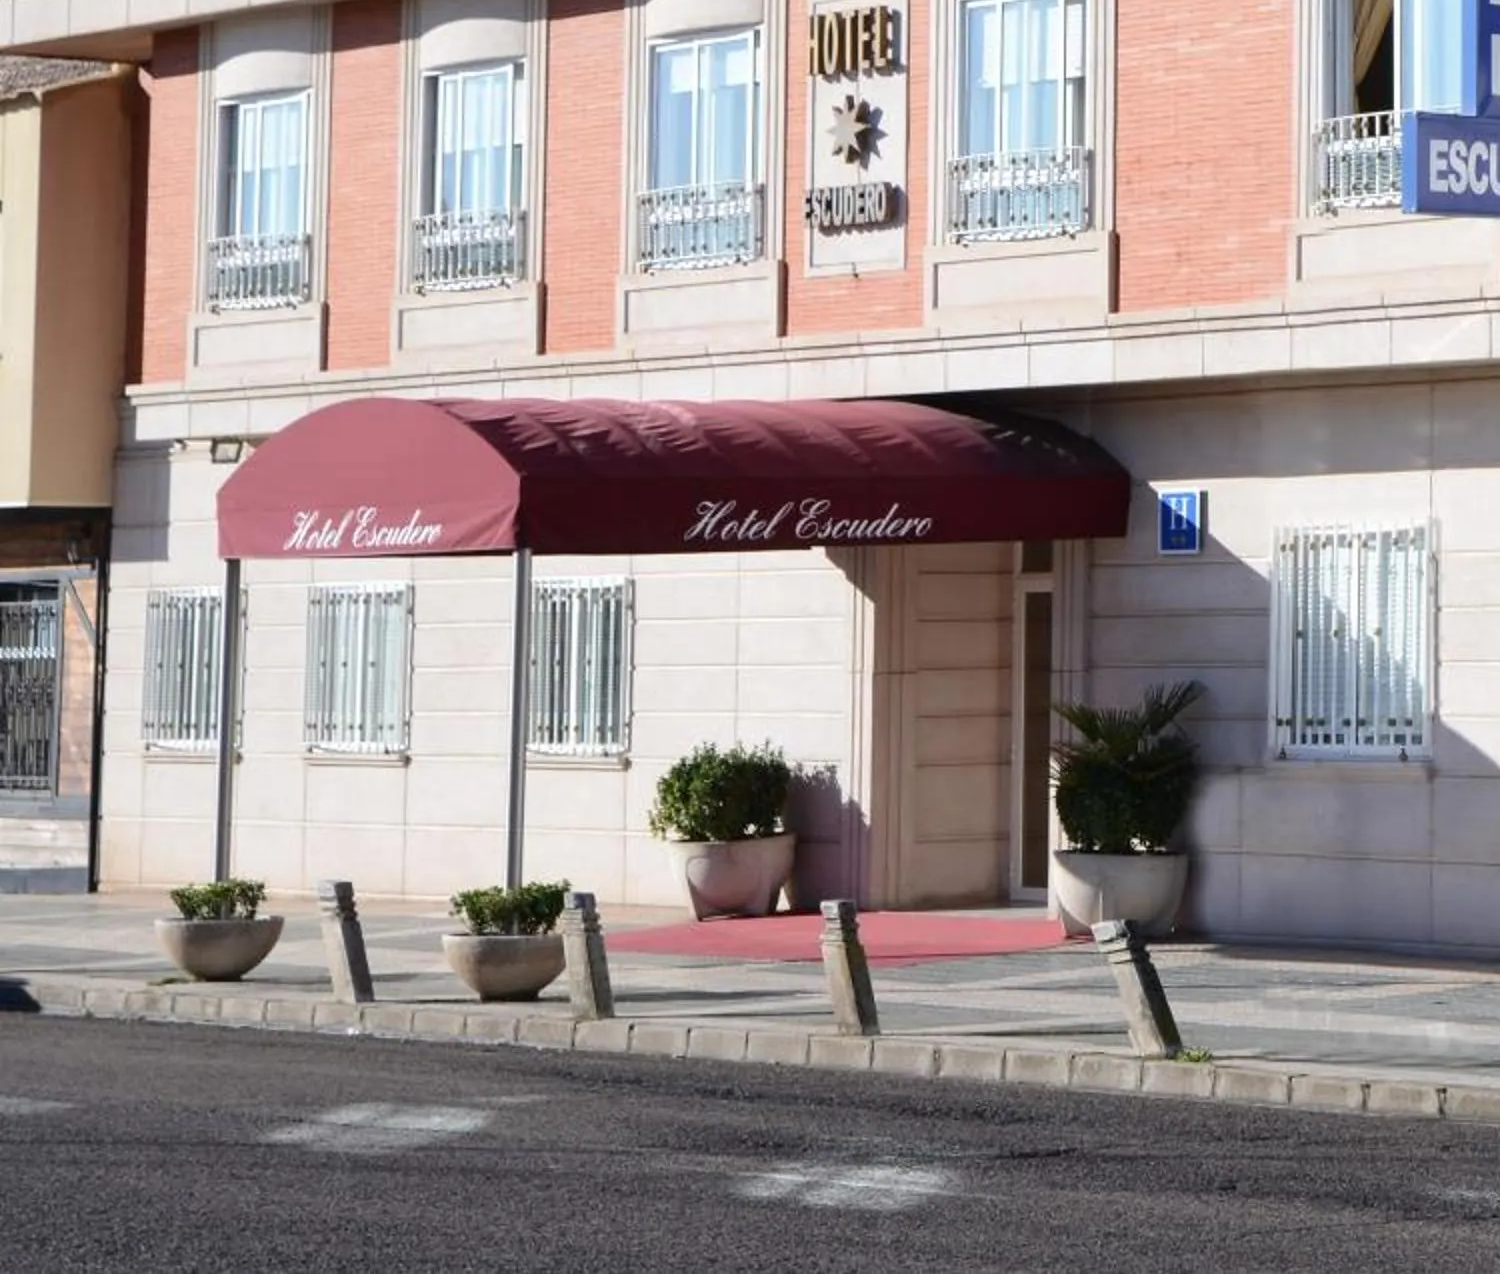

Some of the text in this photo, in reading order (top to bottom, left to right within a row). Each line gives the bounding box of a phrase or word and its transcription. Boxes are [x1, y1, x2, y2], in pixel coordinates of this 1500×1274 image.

[804, 4, 888, 76] HOTEL
[803, 182, 887, 227] ESCUDERO
[283, 505, 443, 551] Hotel Escudero
[683, 497, 934, 541] Hotel Escudero
[1168, 497, 1188, 531] H
